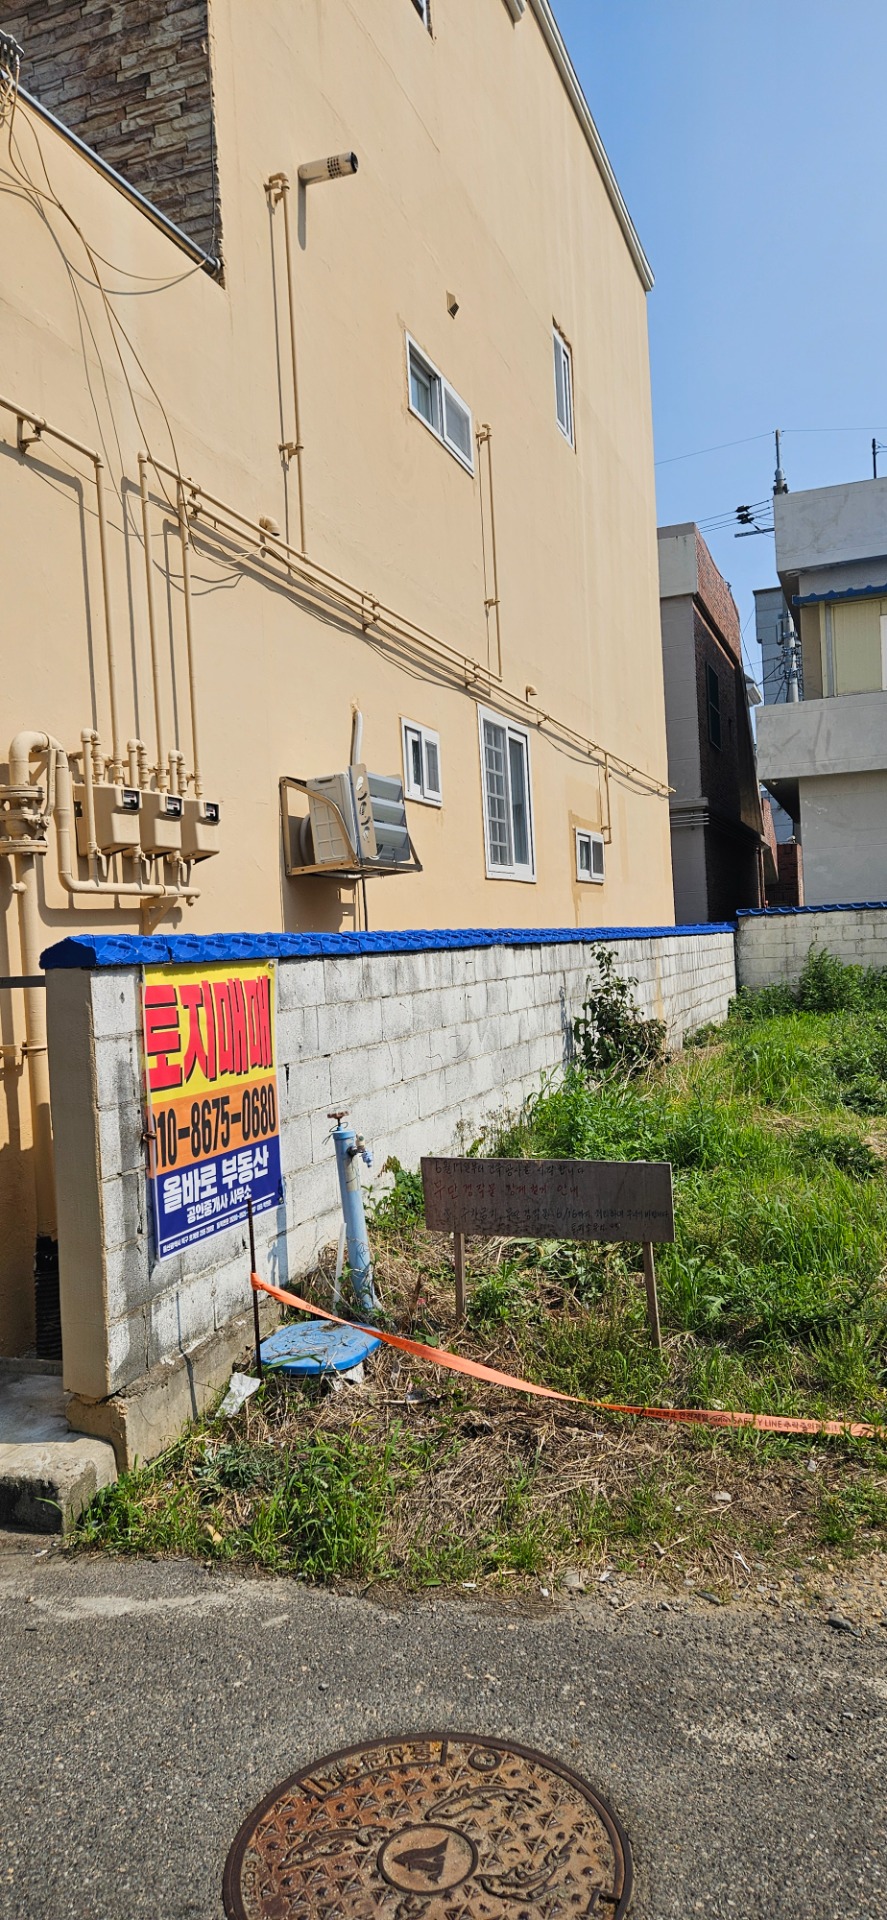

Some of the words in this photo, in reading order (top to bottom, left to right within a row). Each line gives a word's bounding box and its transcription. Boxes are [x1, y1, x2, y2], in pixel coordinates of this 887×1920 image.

[145, 975, 273, 1092] 토지매매
[162, 1162, 218, 1214] 올바로
[222, 1145, 269, 1189] 부동산
[186, 1193, 229, 1224] 공인중개사
[229, 1186, 252, 1206] 사무소
[764, 1419, 782, 1428] LINE
